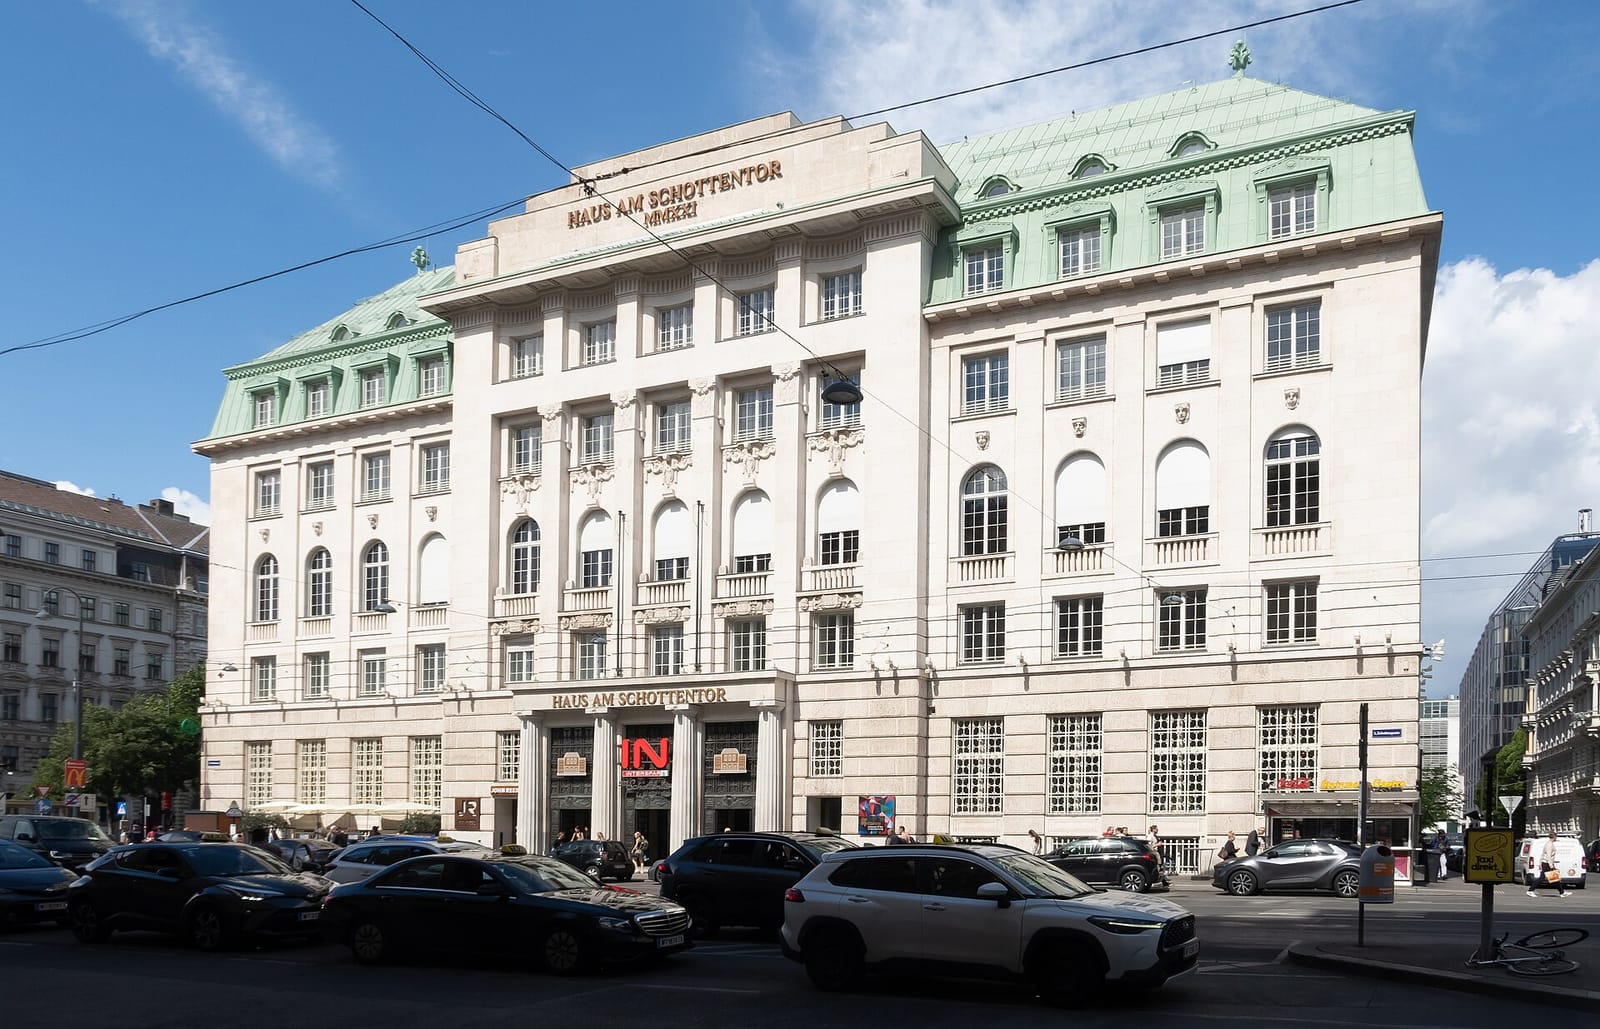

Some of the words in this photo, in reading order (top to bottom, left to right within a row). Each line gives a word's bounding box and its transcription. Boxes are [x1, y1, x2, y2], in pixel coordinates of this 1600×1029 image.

[567, 203, 611, 229] HAUS
[616, 194, 644, 217] AM
[648, 159, 783, 209] SCHOTTENTOR
[643, 201, 698, 229] MMXXI
[552, 694, 589, 709] HAUS
[592, 692, 615, 708] AM
[619, 687, 728, 706] SCHOTTENTOR
[1476, 855, 1494, 863] Taxi
